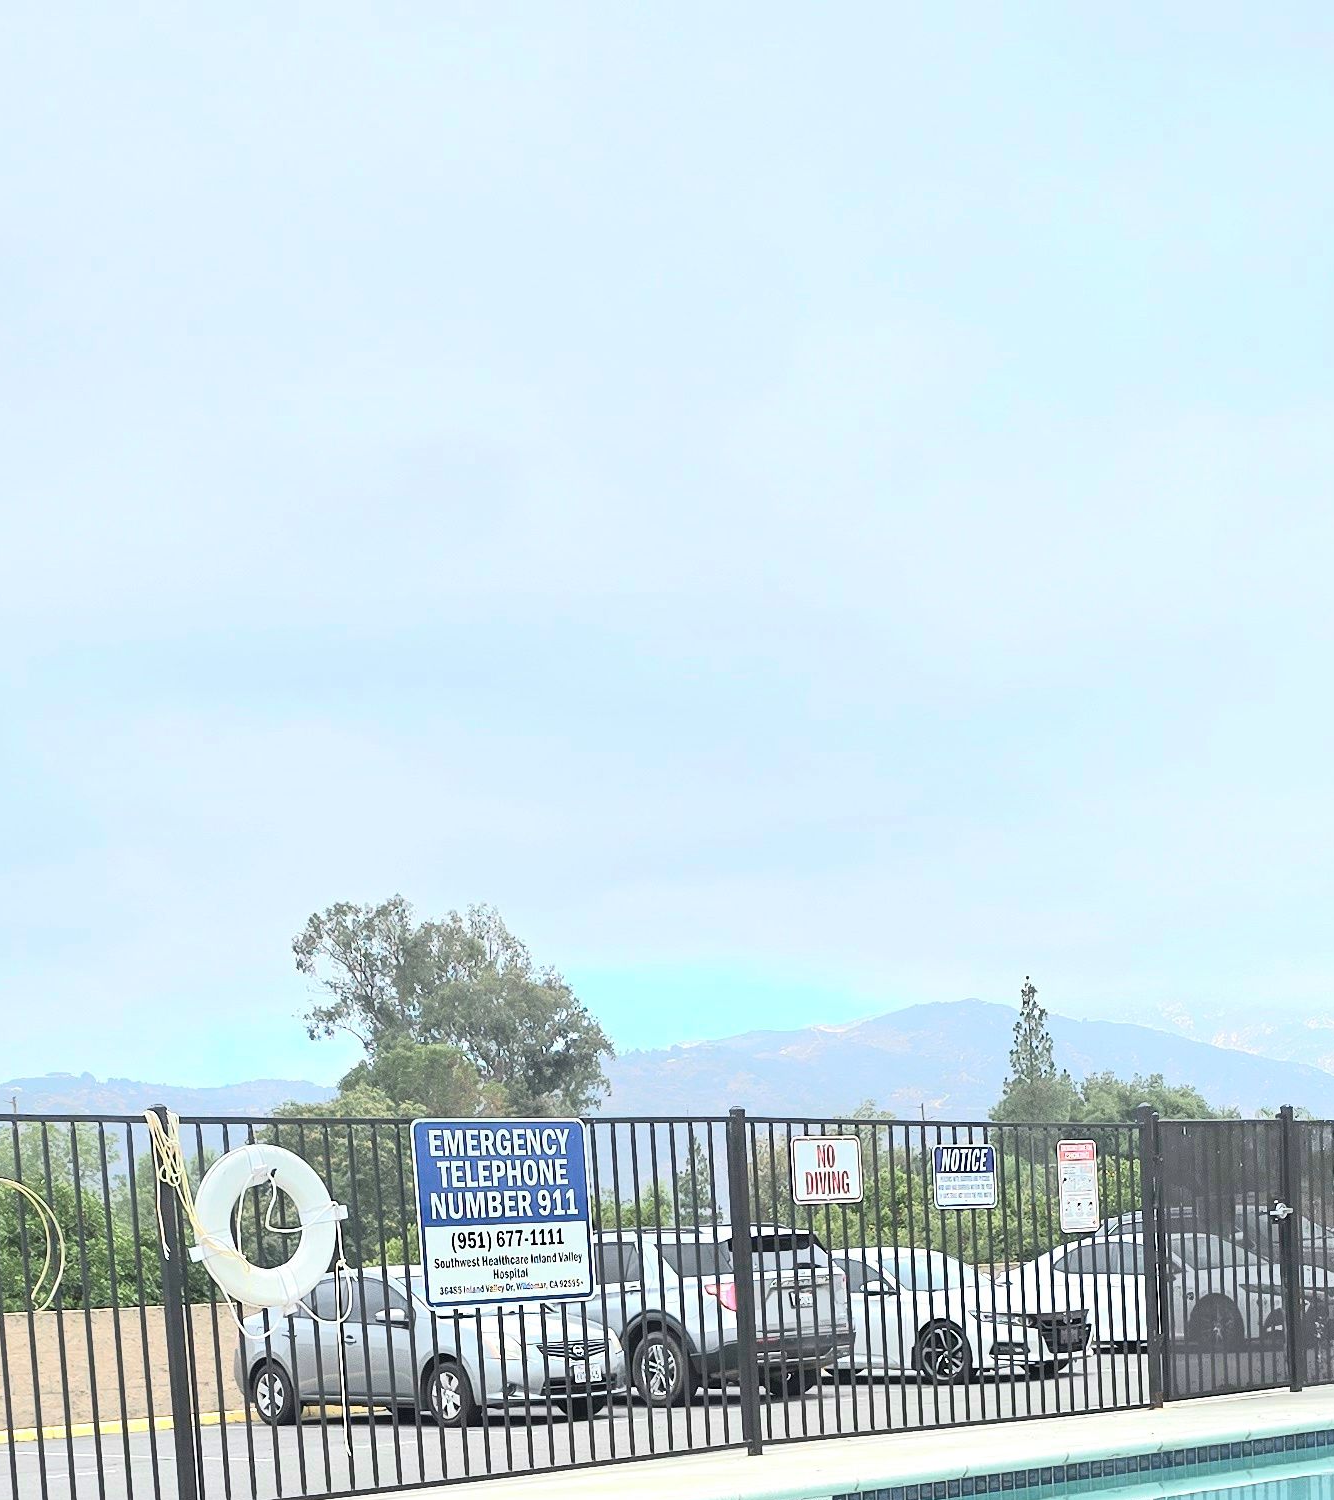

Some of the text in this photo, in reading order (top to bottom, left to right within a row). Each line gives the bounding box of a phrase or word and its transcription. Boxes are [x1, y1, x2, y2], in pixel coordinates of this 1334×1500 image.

[428, 1128, 569, 1157] EMERGENCY
[817, 1144, 836, 1168] NO
[941, 1148, 989, 1172] NOTICE
[436, 1158, 569, 1188] TELEPHONE
[805, 1170, 851, 1196] DIVING
[430, 1188, 579, 1220] NUMBER 911
[451, 1228, 565, 1254] (951) 677-1111
[433, 1252, 583, 1269] Southwest Healthcare Inland Valley
[493, 1267, 529, 1280] Hospital
